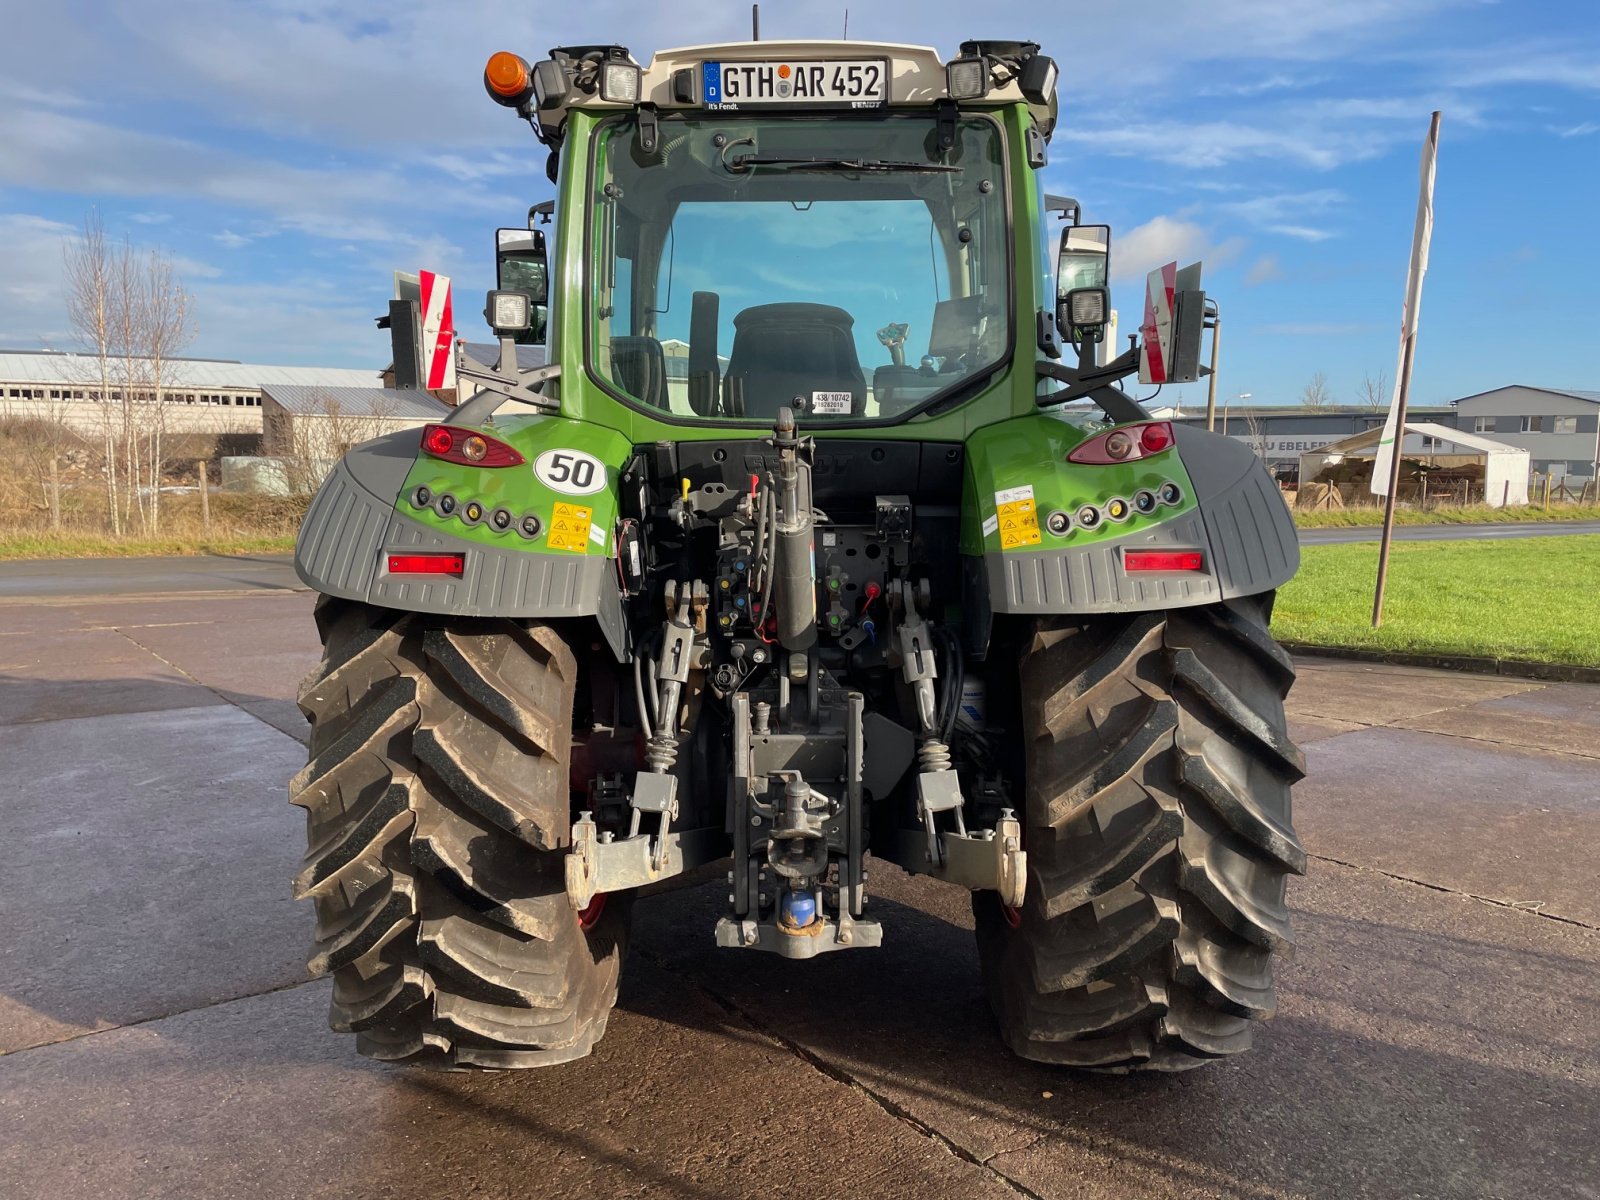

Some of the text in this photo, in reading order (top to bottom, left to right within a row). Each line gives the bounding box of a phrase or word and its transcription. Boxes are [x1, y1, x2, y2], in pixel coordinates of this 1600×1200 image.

[709, 87, 716, 96] D
[723, 65, 879, 97] GTH AR 452
[851, 101, 882, 109] FENDT
[547, 453, 595, 488] 50
[743, 453, 855, 477] FEDT
